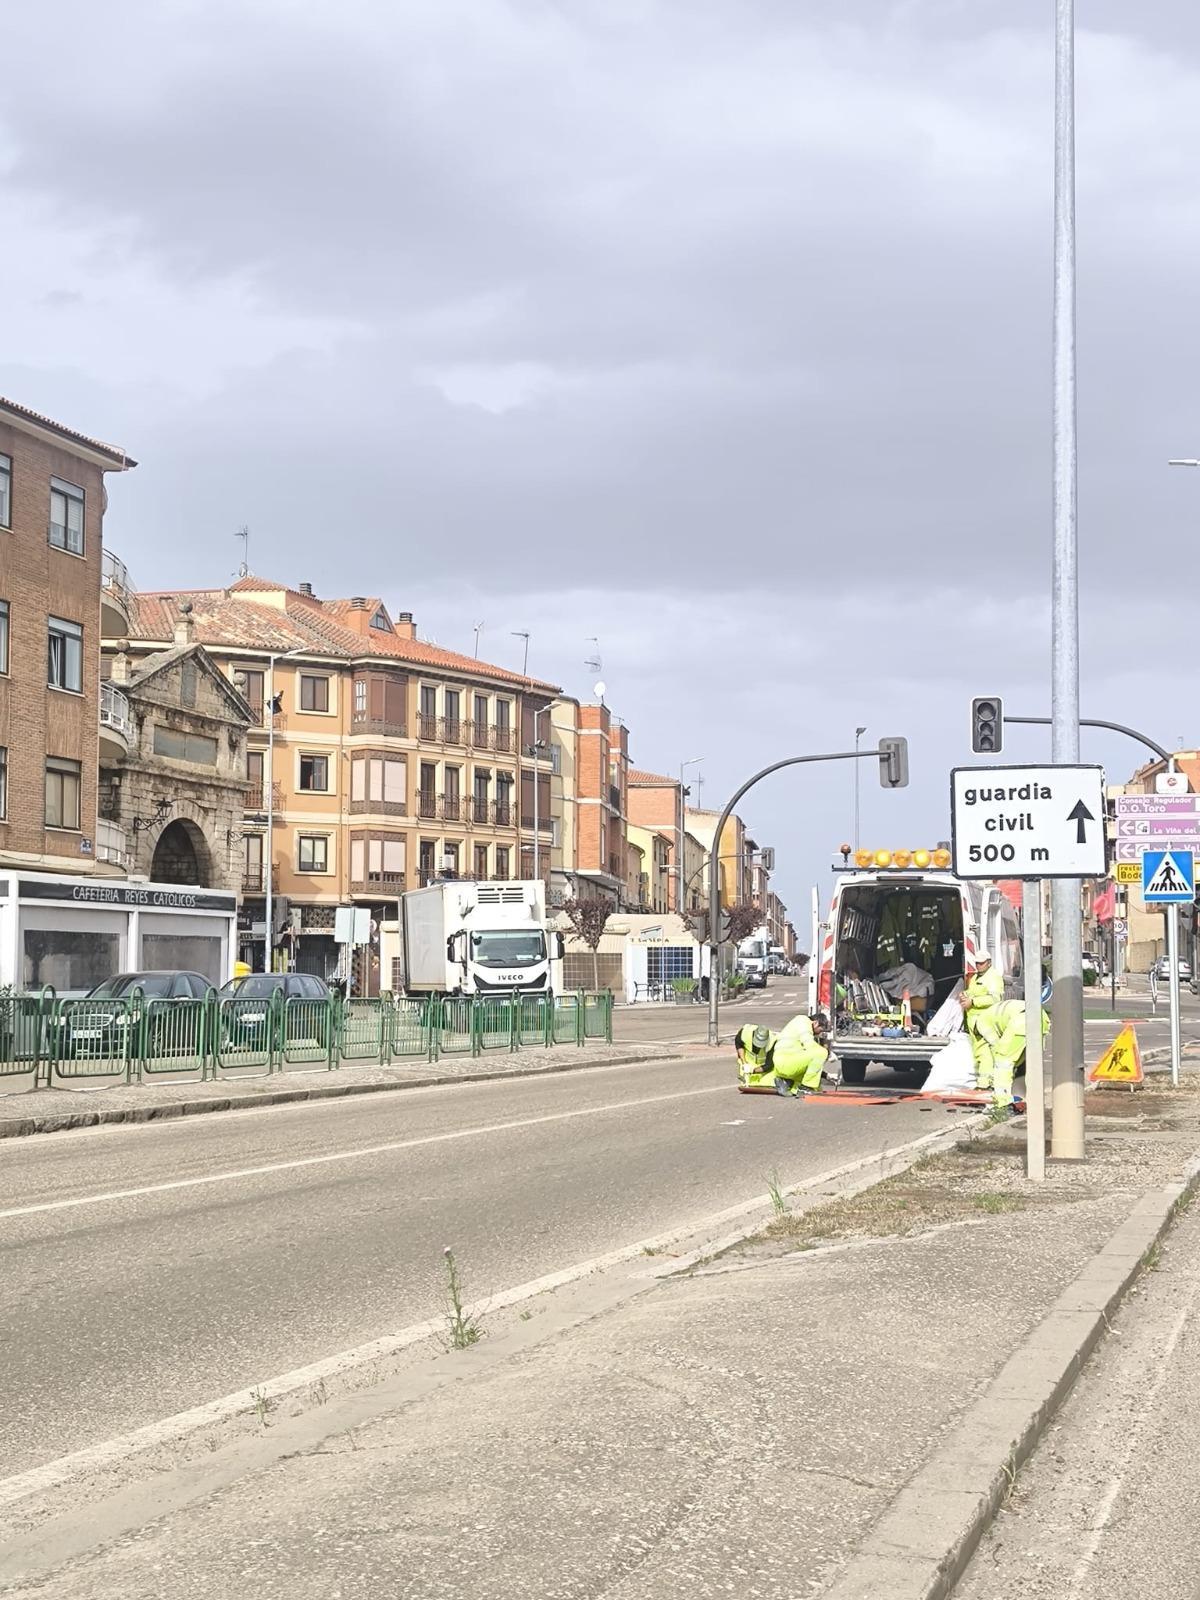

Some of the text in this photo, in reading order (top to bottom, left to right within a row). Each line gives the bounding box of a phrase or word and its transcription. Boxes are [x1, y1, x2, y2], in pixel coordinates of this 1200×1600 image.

[965, 783, 1052, 805] guardia
[1144, 804, 1166, 813] Toro
[985, 813, 1034, 831] civil
[969, 844, 1049, 862] 500 m
[73, 886, 196, 907] CAFETERIA REYES CATOLICOS
